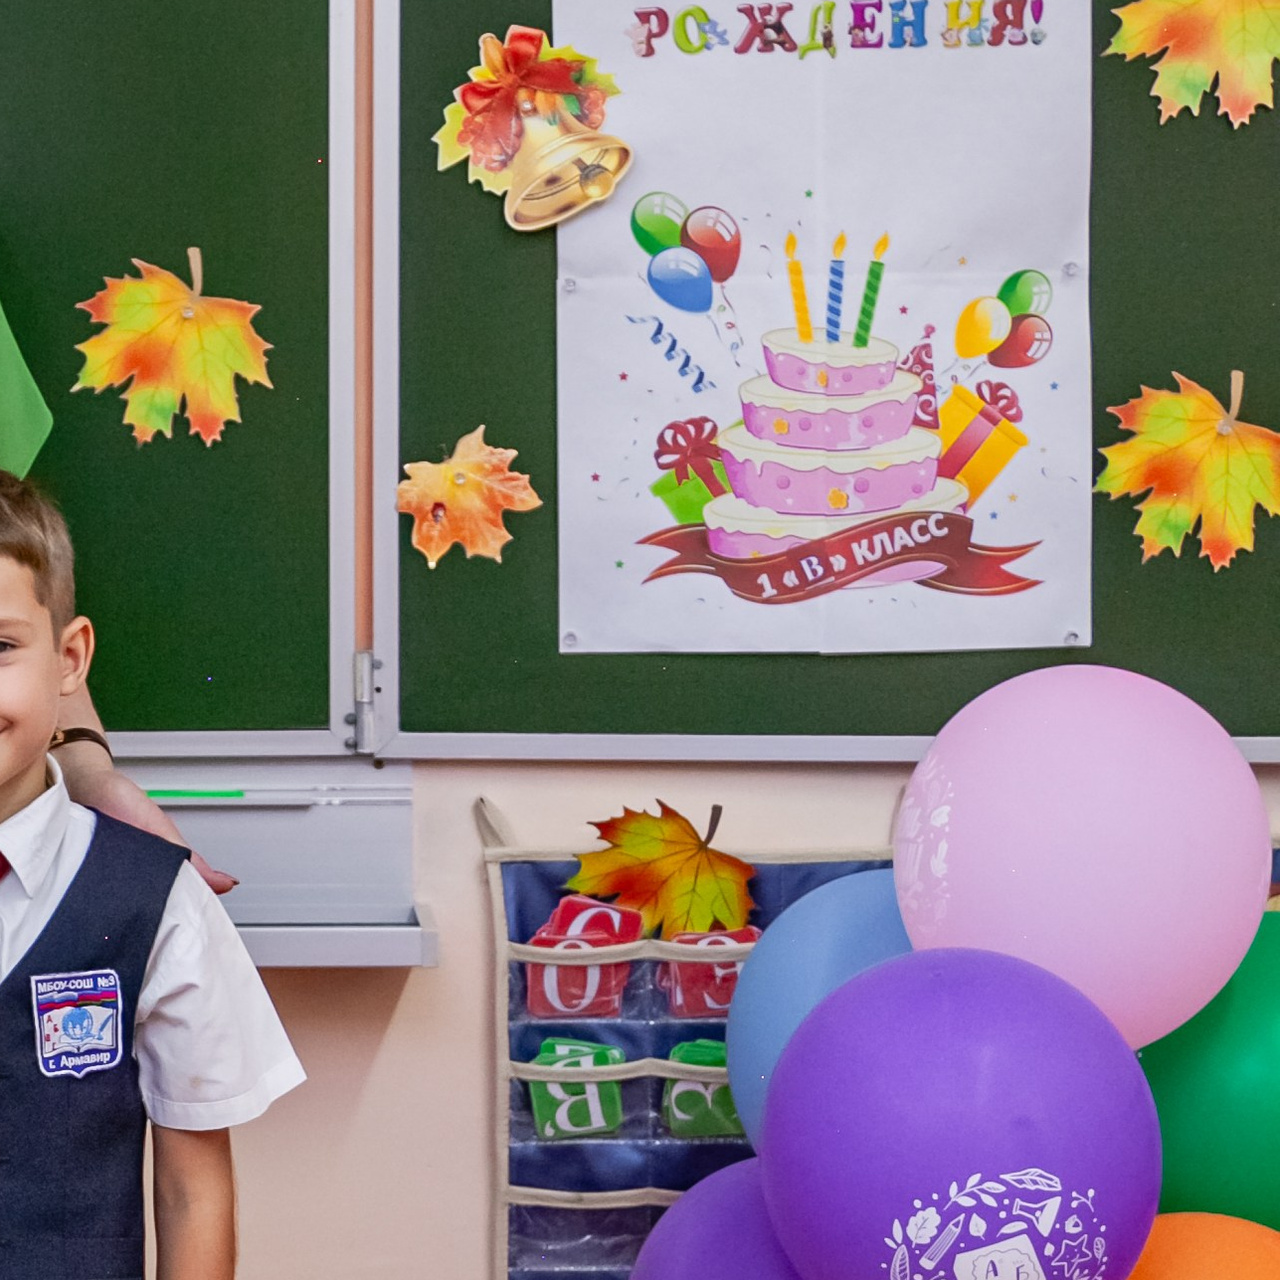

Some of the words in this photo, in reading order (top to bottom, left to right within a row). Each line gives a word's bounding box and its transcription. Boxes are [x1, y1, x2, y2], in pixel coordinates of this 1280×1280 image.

[756, 573, 778, 599] 1
[850, 513, 950, 567] КЛАСС
[37, 978, 93, 994] МБОУ-СОШ
[97, 975, 116, 988] №3
[60, 1052, 111, 1068] Армавир
